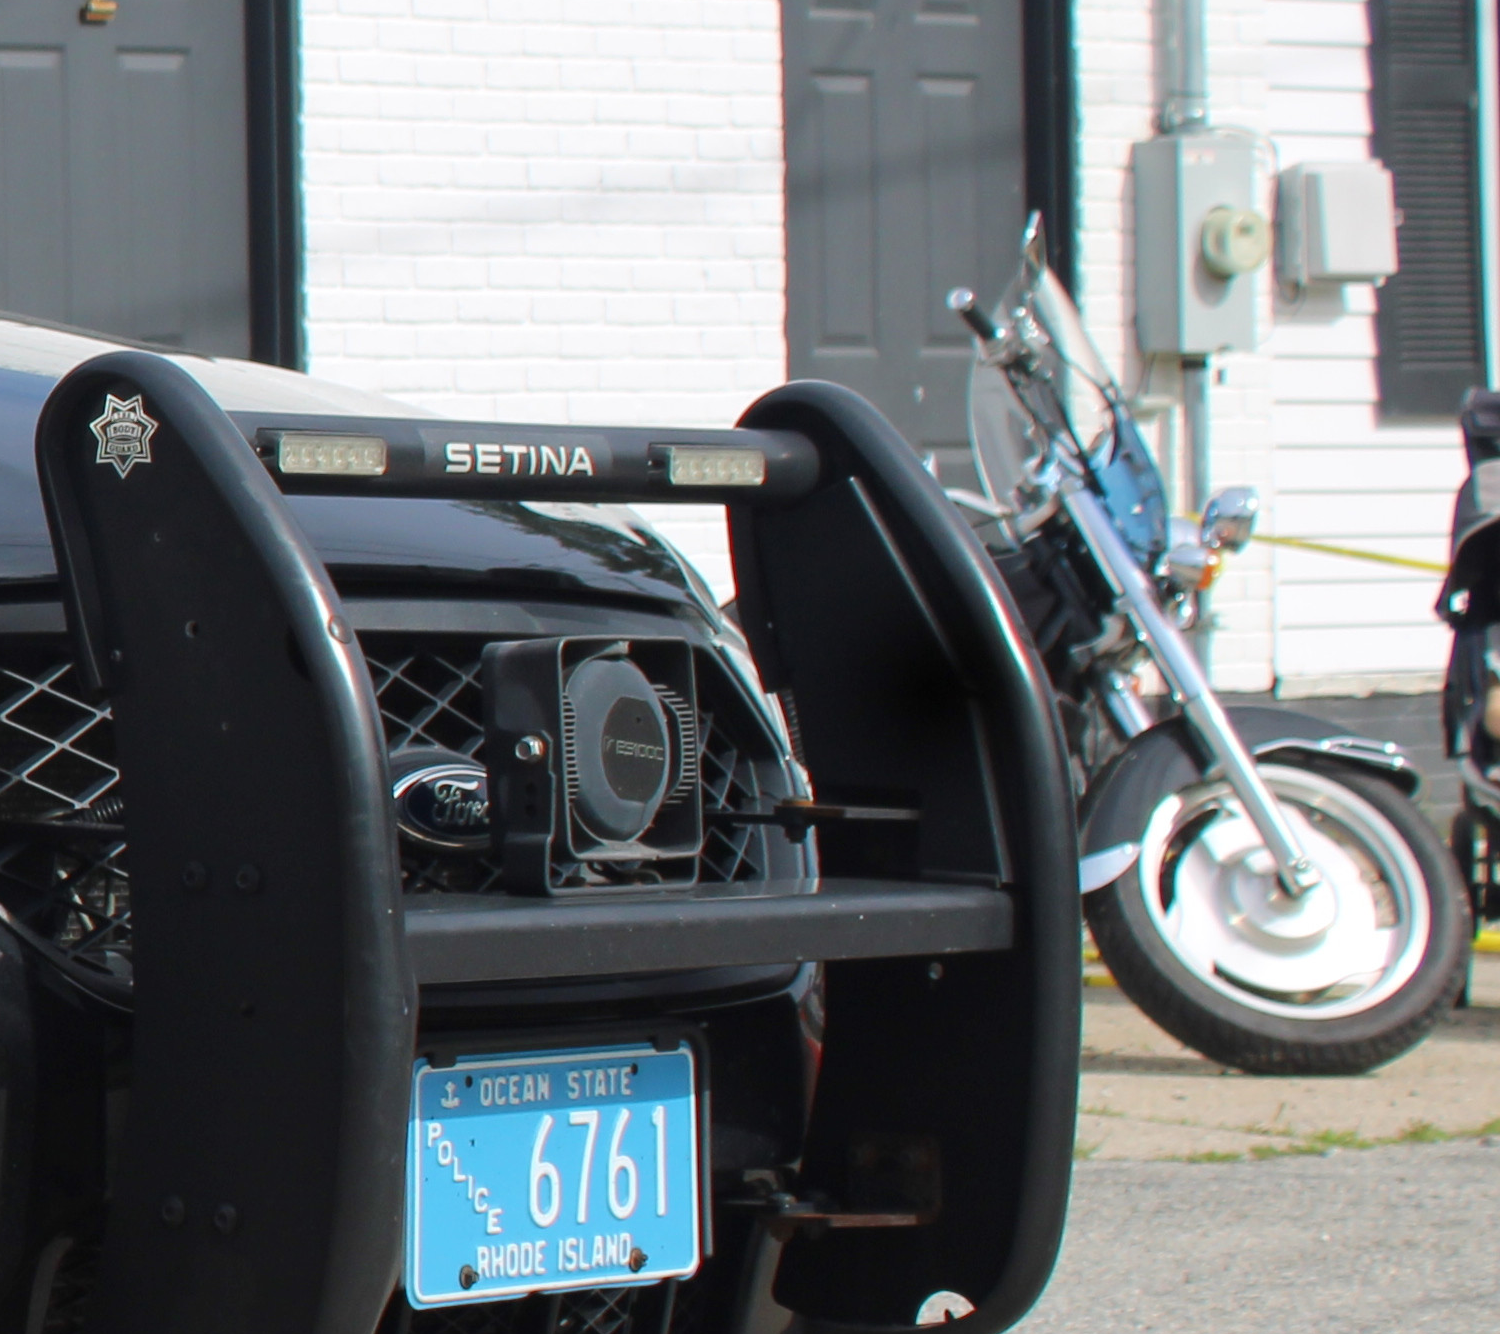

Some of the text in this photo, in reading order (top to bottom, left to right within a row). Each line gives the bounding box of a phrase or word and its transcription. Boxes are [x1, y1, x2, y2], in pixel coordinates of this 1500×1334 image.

[444, 442, 596, 477] SETINA
[479, 1065, 634, 1107] OCEAN STATE
[427, 1121, 503, 1235] POLICE
[528, 1104, 667, 1228] 6761
[476, 1231, 634, 1279] RHODE ISLAND
